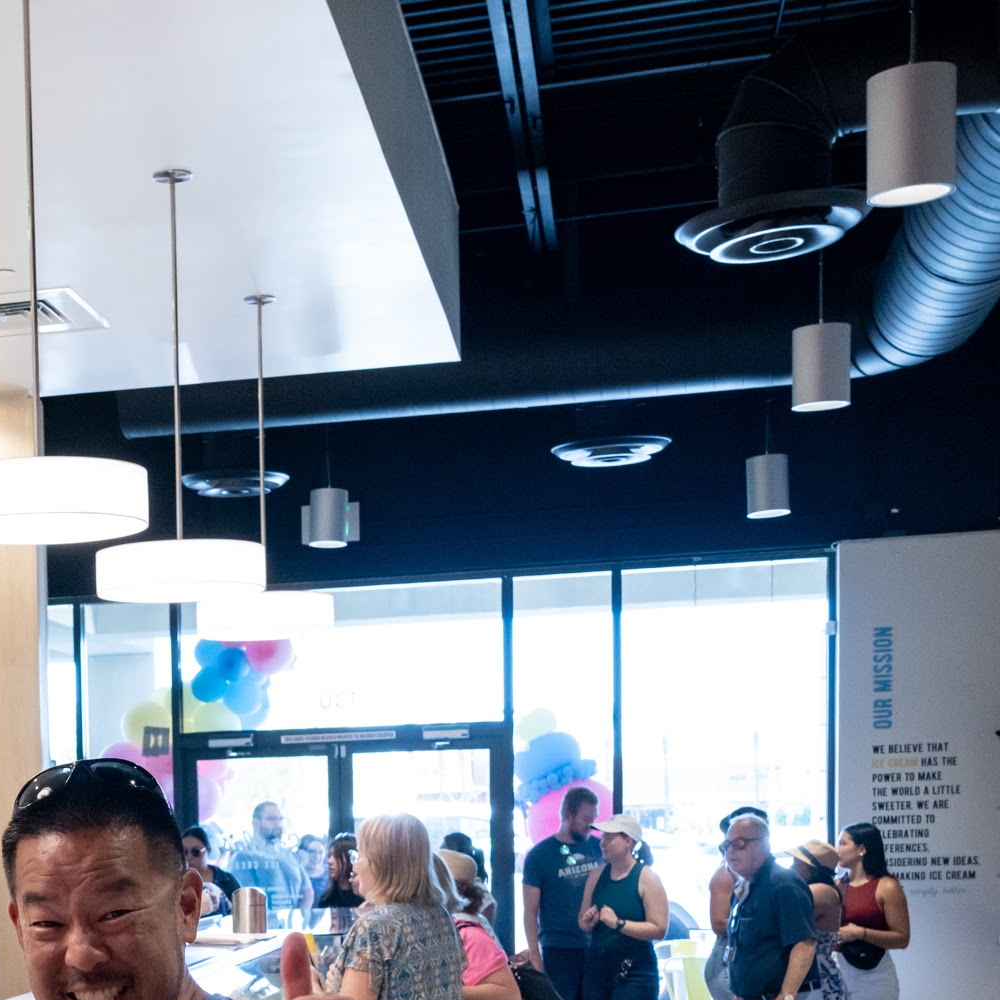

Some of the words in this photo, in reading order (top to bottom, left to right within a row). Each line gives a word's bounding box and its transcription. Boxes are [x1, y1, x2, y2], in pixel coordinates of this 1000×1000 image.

[873, 626, 893, 693] MISSION
[873, 698, 893, 730] OUR
[872, 744, 885, 754] WE
[888, 743, 924, 754] BELIEVE
[927, 742, 949, 752] THAT
[872, 759, 885, 769] ICE
[888, 758, 918, 768] CREAM
[921, 757, 938, 767] HAS
[942, 756, 957, 766] THE
[872, 772, 901, 783] POWER
[905, 772, 915, 782] TO
[918, 771, 943, 781] MAKE
[872, 787, 887, 797] THE
[891, 786, 920, 796] WORLD
[924, 786, 929, 795] A
[932, 785, 961, 795] LITTLE
[872, 801, 913, 811] SWEETER.
[917, 800, 930, 810] WE
[933, 800, 949, 809] ARE
[872, 815, 922, 825] COMMITTED
[926, 814, 936, 824] TO
[882, 829, 929, 839] LEBRATING
[931, 856, 950, 866] NEW
[953, 856, 980, 866] IDEAS,
[558, 861, 600, 878] ARIZONA
[929, 871, 942, 880] ICE
[946, 870, 976, 880] CREAM
